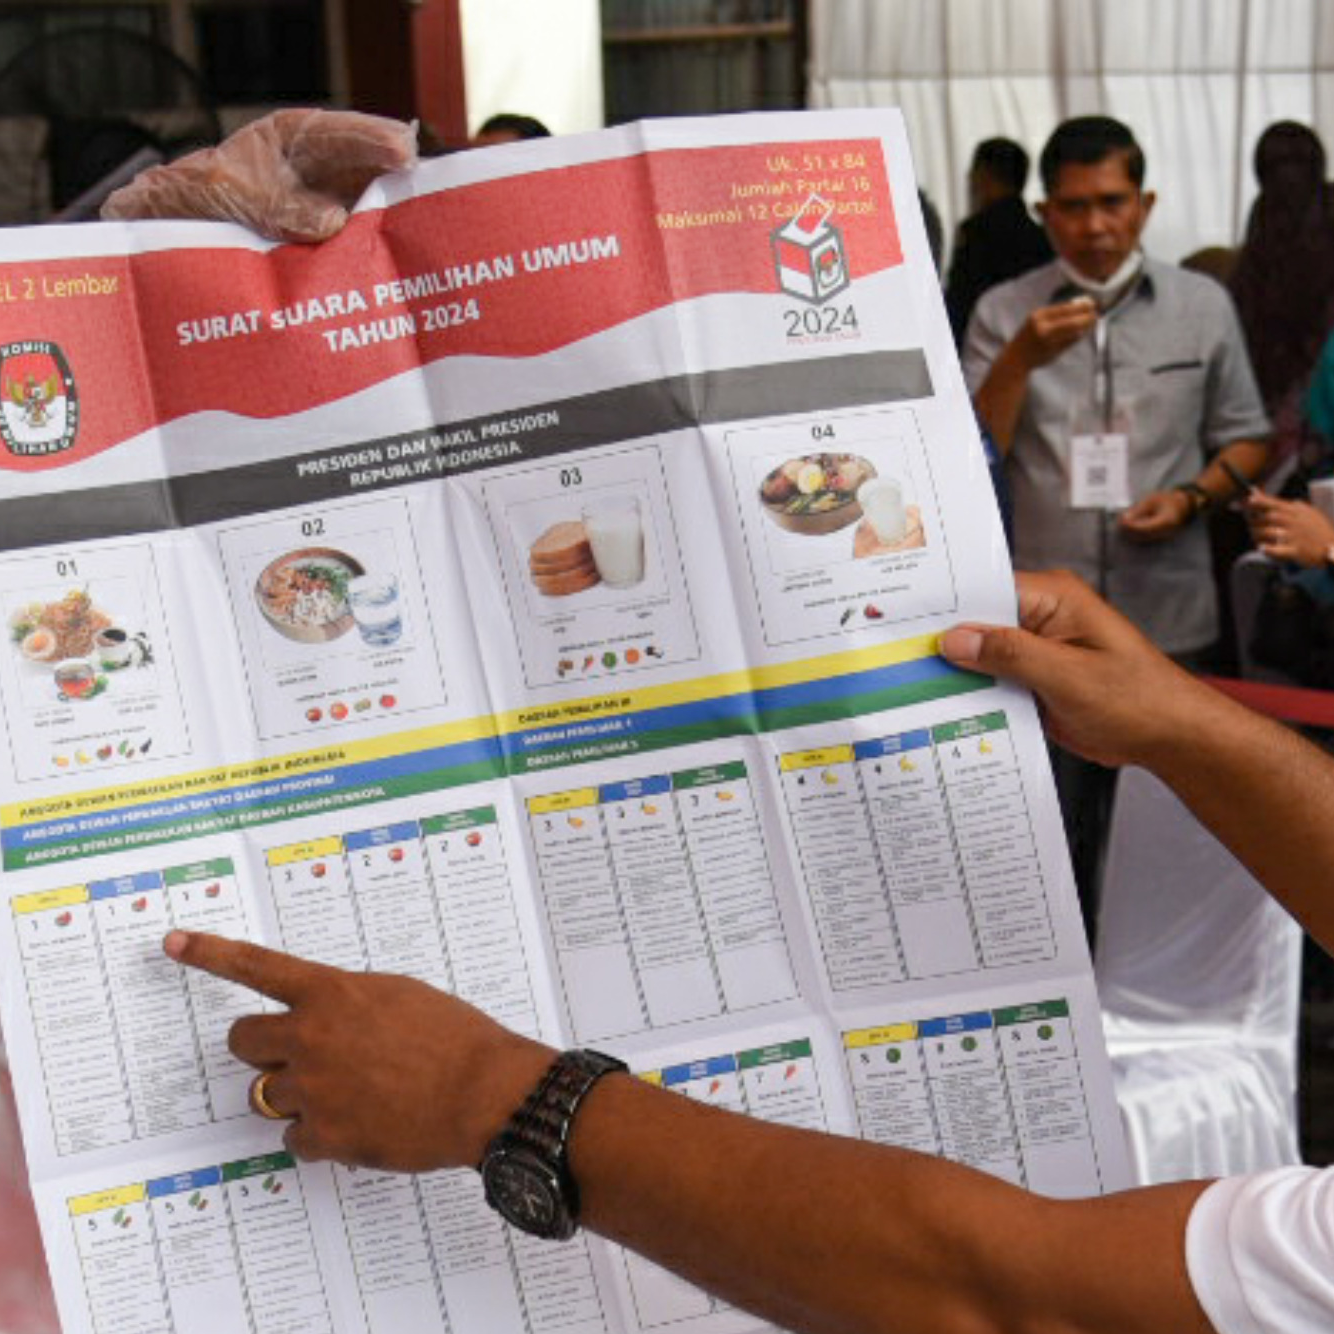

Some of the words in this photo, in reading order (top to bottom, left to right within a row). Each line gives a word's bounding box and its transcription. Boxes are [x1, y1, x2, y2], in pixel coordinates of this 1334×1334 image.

[657, 206, 742, 229] Maksimal
[23, 279, 35, 299] 2
[177, 309, 260, 345] SURAT
[271, 290, 367, 330] SUARA
[375, 256, 514, 306] PEMILIHAN
[523, 235, 620, 273] UMUM
[323, 314, 417, 351] TAHUN
[422, 299, 480, 331] 2024
[783, 304, 858, 337] 2024
[812, 424, 835, 441] 04
[297, 448, 382, 478] PRESIDEN
[387, 438, 426, 459] DAN
[481, 411, 559, 440] PRESIDEN
[560, 467, 582, 487] 03
[302, 519, 325, 537] 02
[56, 560, 78, 577] 01
